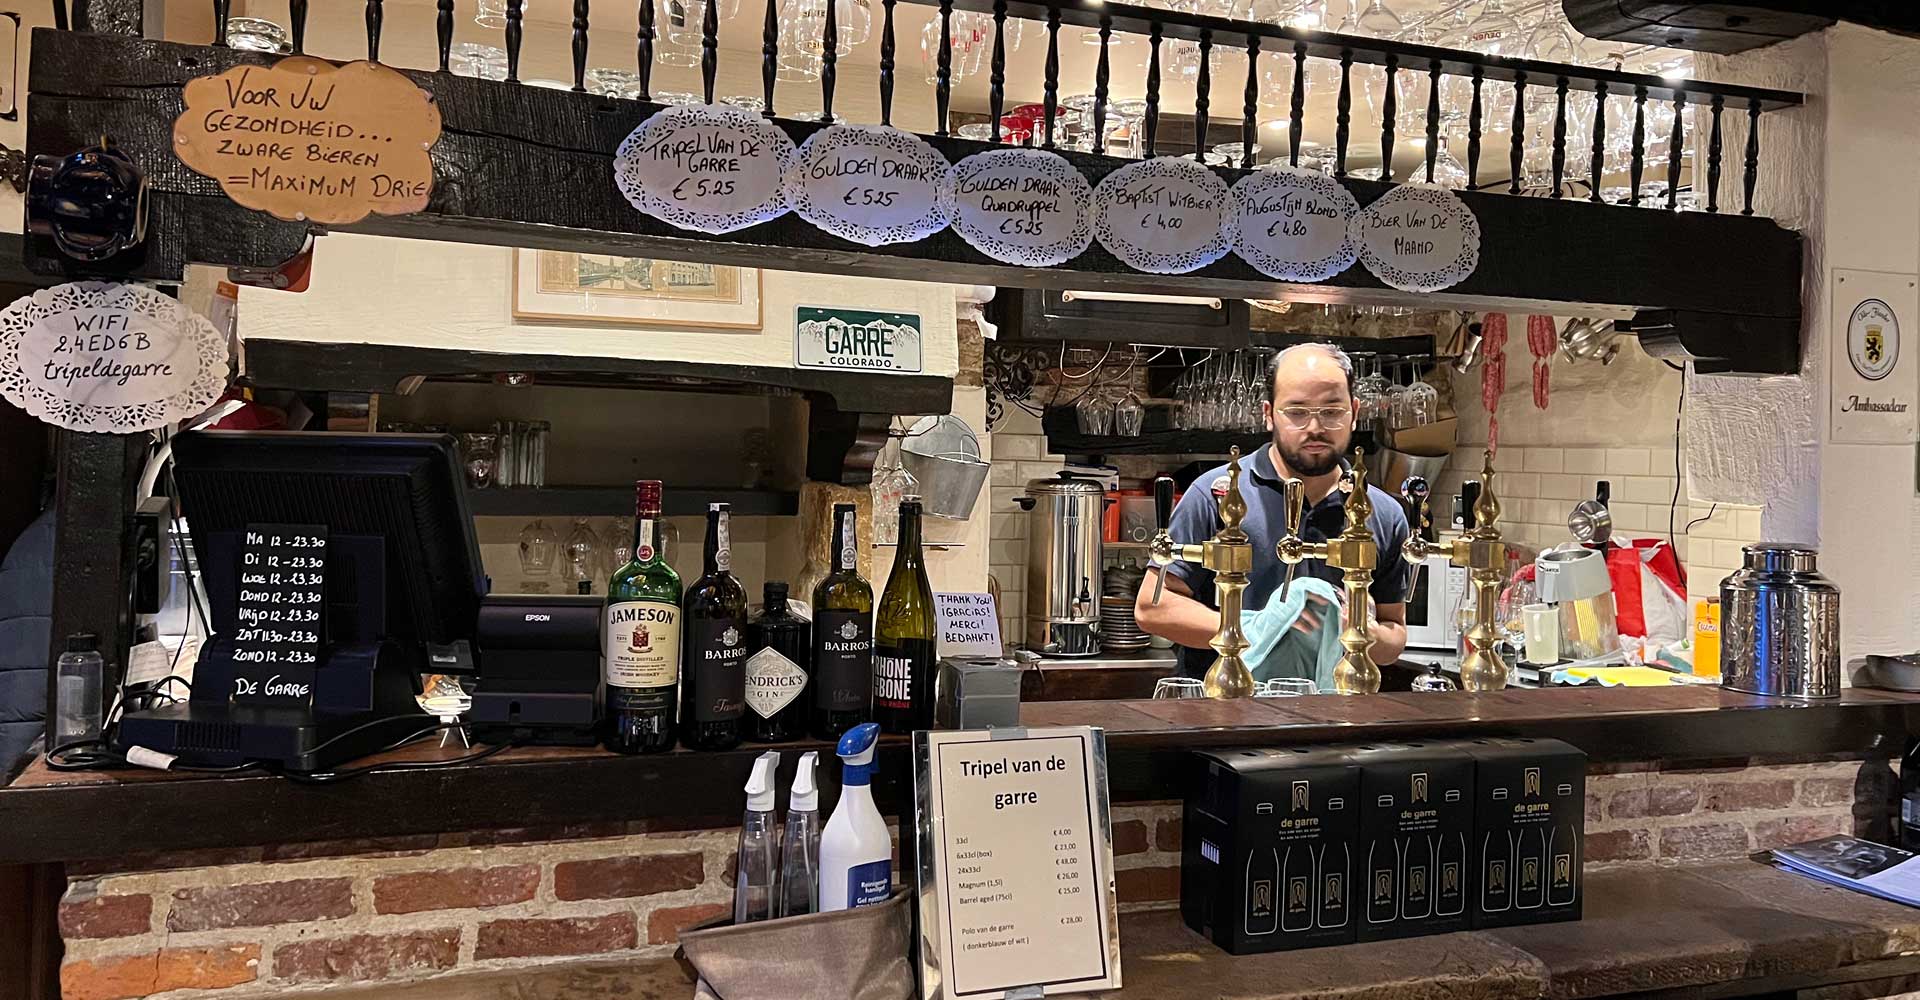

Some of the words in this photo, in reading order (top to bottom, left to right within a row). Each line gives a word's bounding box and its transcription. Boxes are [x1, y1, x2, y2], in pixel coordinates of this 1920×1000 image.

[226, 68, 280, 109] VOOR
[291, 78, 335, 111] UW
[217, 140, 294, 160] ZWARE
[708, 131, 734, 155] VAN
[740, 139, 760, 157] DE
[688, 152, 741, 173] GARRE
[811, 156, 878, 179] GULDEN
[882, 159, 929, 183] DRAAK
[696, 179, 736, 197] 5.25
[961, 169, 1019, 194] GULDEN
[1022, 177, 1060, 198] DRAAK
[981, 195, 1061, 220] QUADRUPPEL
[1305, 199, 1338, 218] BLOND
[1406, 209, 1427, 228] VAN
[1431, 214, 1448, 229] DE
[1394, 236, 1434, 255] MAAND
[73, 314, 129, 331] WIFI
[825, 325, 894, 358] GARRE
[829, 356, 892, 368] COLORADO
[44, 356, 173, 388] tripeldegarre
[240, 590, 270, 602] DOND
[937, 594, 971, 604] THANK
[525, 614, 551, 622] EPSON
[611, 608, 675, 625] JAMESON
[235, 628, 263, 641] ZAT
[945, 631, 994, 645] BEDANKT!
[705, 646, 746, 660] BARROS
[824, 641, 870, 651] BARROS
[232, 648, 265, 663] ZOND
[235, 677, 258, 695] DE
[265, 674, 309, 698] GARRE
[745, 674, 803, 687] ENDRICK'S
[879, 678, 912, 700] BONE
[960, 758, 1007, 779] Tripel
[1012, 760, 1041, 773] van
[1046, 755, 1066, 771] de
[995, 791, 1038, 810] garre
[1514, 803, 1526, 813] de
[1526, 803, 1549, 814] garre
[1281, 818, 1293, 828] de
[1294, 817, 1319, 829] garre
[1401, 810, 1412, 819] de
[1413, 810, 1437, 820] garre
[1058, 828, 1071, 836] 4,00
[958, 880, 986, 890] Magnum
[960, 896, 979, 905] Barrel
[980, 895, 995, 903] aged
[998, 924, 1015, 932] garre
[967, 940, 1007, 950] donkerblauw
[1007, 937, 1015, 945] of
